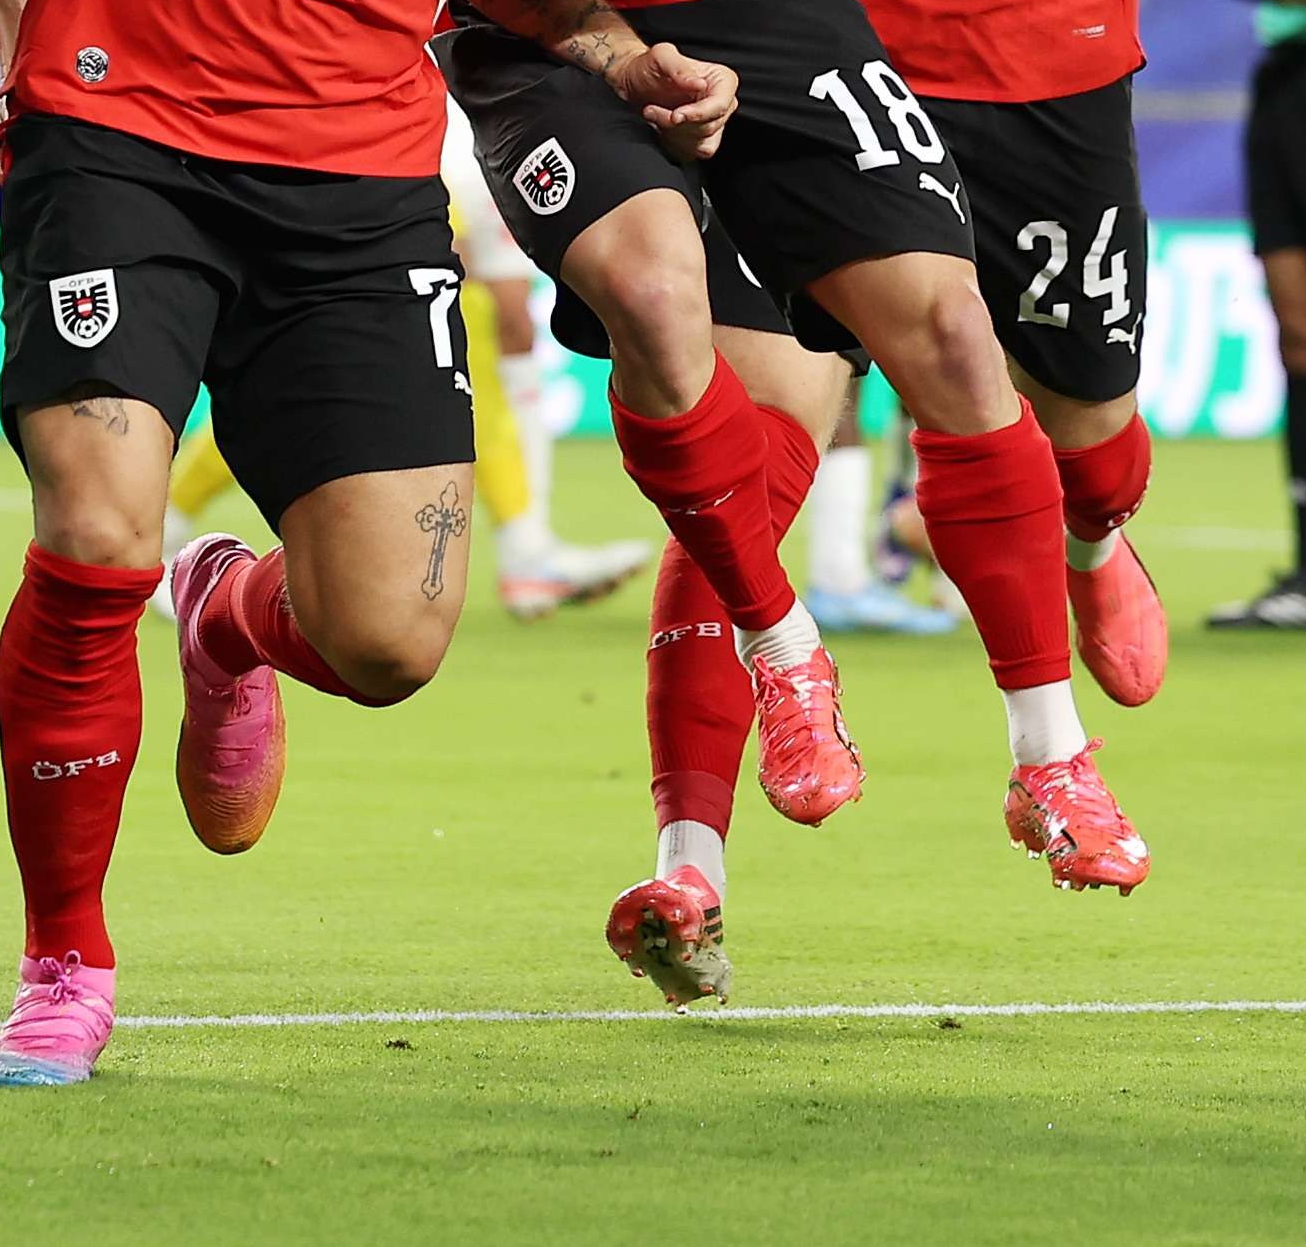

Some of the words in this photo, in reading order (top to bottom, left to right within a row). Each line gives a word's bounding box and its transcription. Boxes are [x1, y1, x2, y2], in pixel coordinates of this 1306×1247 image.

[808, 59, 946, 171] 18
[408, 268, 459, 368] 7
[1016, 206, 1131, 328] 24
[32, 750, 120, 780] ÖFB
